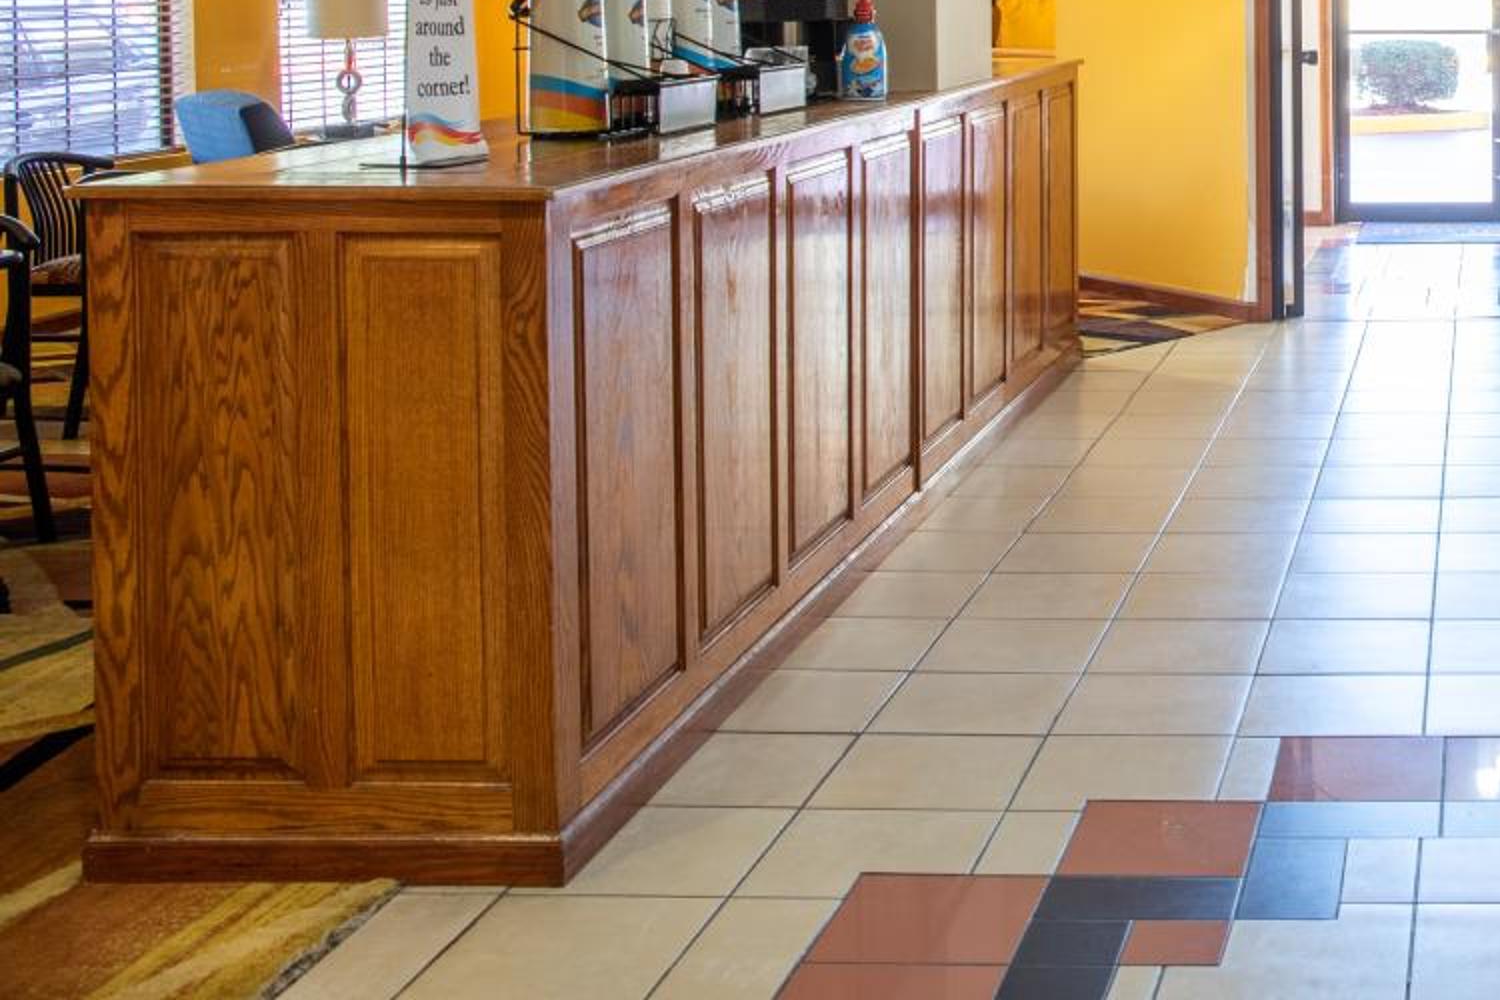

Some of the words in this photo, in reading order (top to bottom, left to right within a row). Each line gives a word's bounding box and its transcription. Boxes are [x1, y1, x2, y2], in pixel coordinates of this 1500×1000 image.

[415, 15, 465, 36] around
[429, 45, 451, 67] the
[417, 73, 470, 98] corner!
